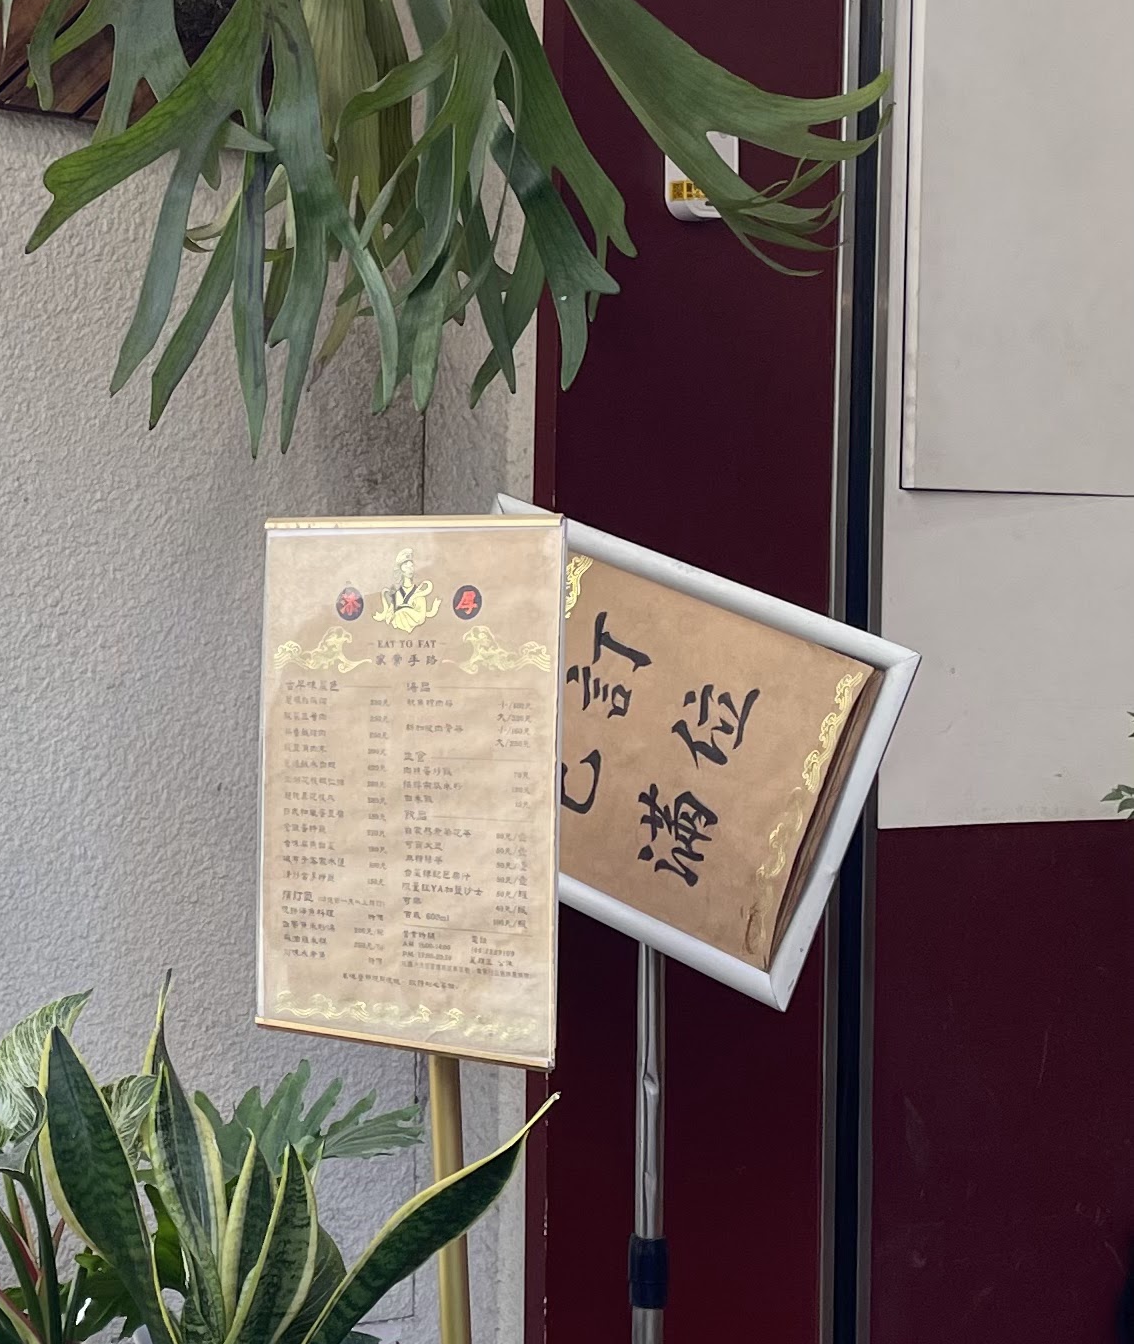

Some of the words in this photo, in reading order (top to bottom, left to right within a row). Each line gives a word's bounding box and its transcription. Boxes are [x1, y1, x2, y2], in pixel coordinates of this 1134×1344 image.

[377, 639, 394, 648] EAT
[400, 639, 413, 648] TO
[417, 639, 437, 648] FAT
